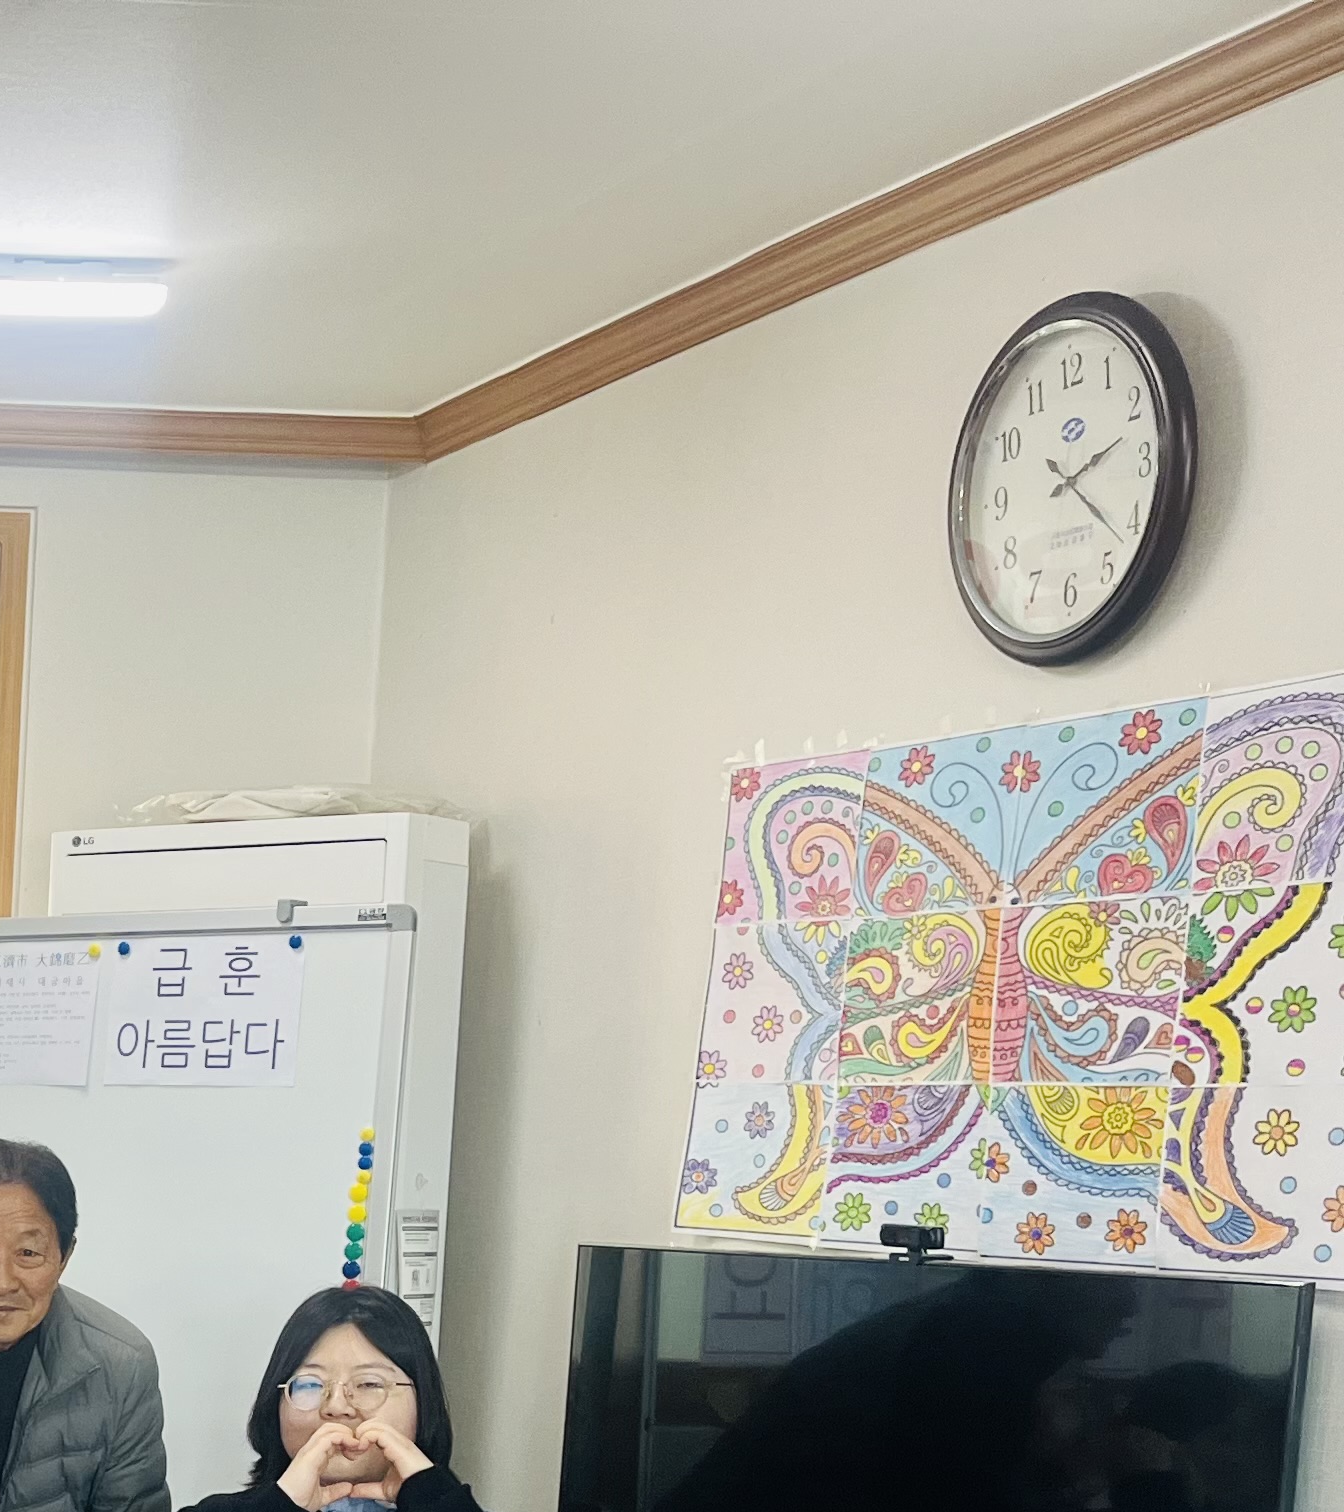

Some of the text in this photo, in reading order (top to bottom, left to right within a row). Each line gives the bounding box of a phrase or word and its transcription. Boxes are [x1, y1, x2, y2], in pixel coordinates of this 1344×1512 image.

[1061, 352, 1083, 390] 12
[1103, 354, 1111, 390] 1
[1027, 380, 1044, 416] 11
[1128, 386, 1141, 422] 2
[1001, 427, 1020, 462] 10
[1138, 442, 1151, 478] 3
[994, 487, 1008, 521] 9
[1127, 499, 1140, 535] 4
[1003, 536, 1017, 570] 8
[1101, 551, 1113, 586] 5
[1028, 570, 1042, 604] 7
[1063, 573, 1077, 607] 6
[83, 837, 95, 846] LG
[117, 1018, 285, 1070] 아름답다
